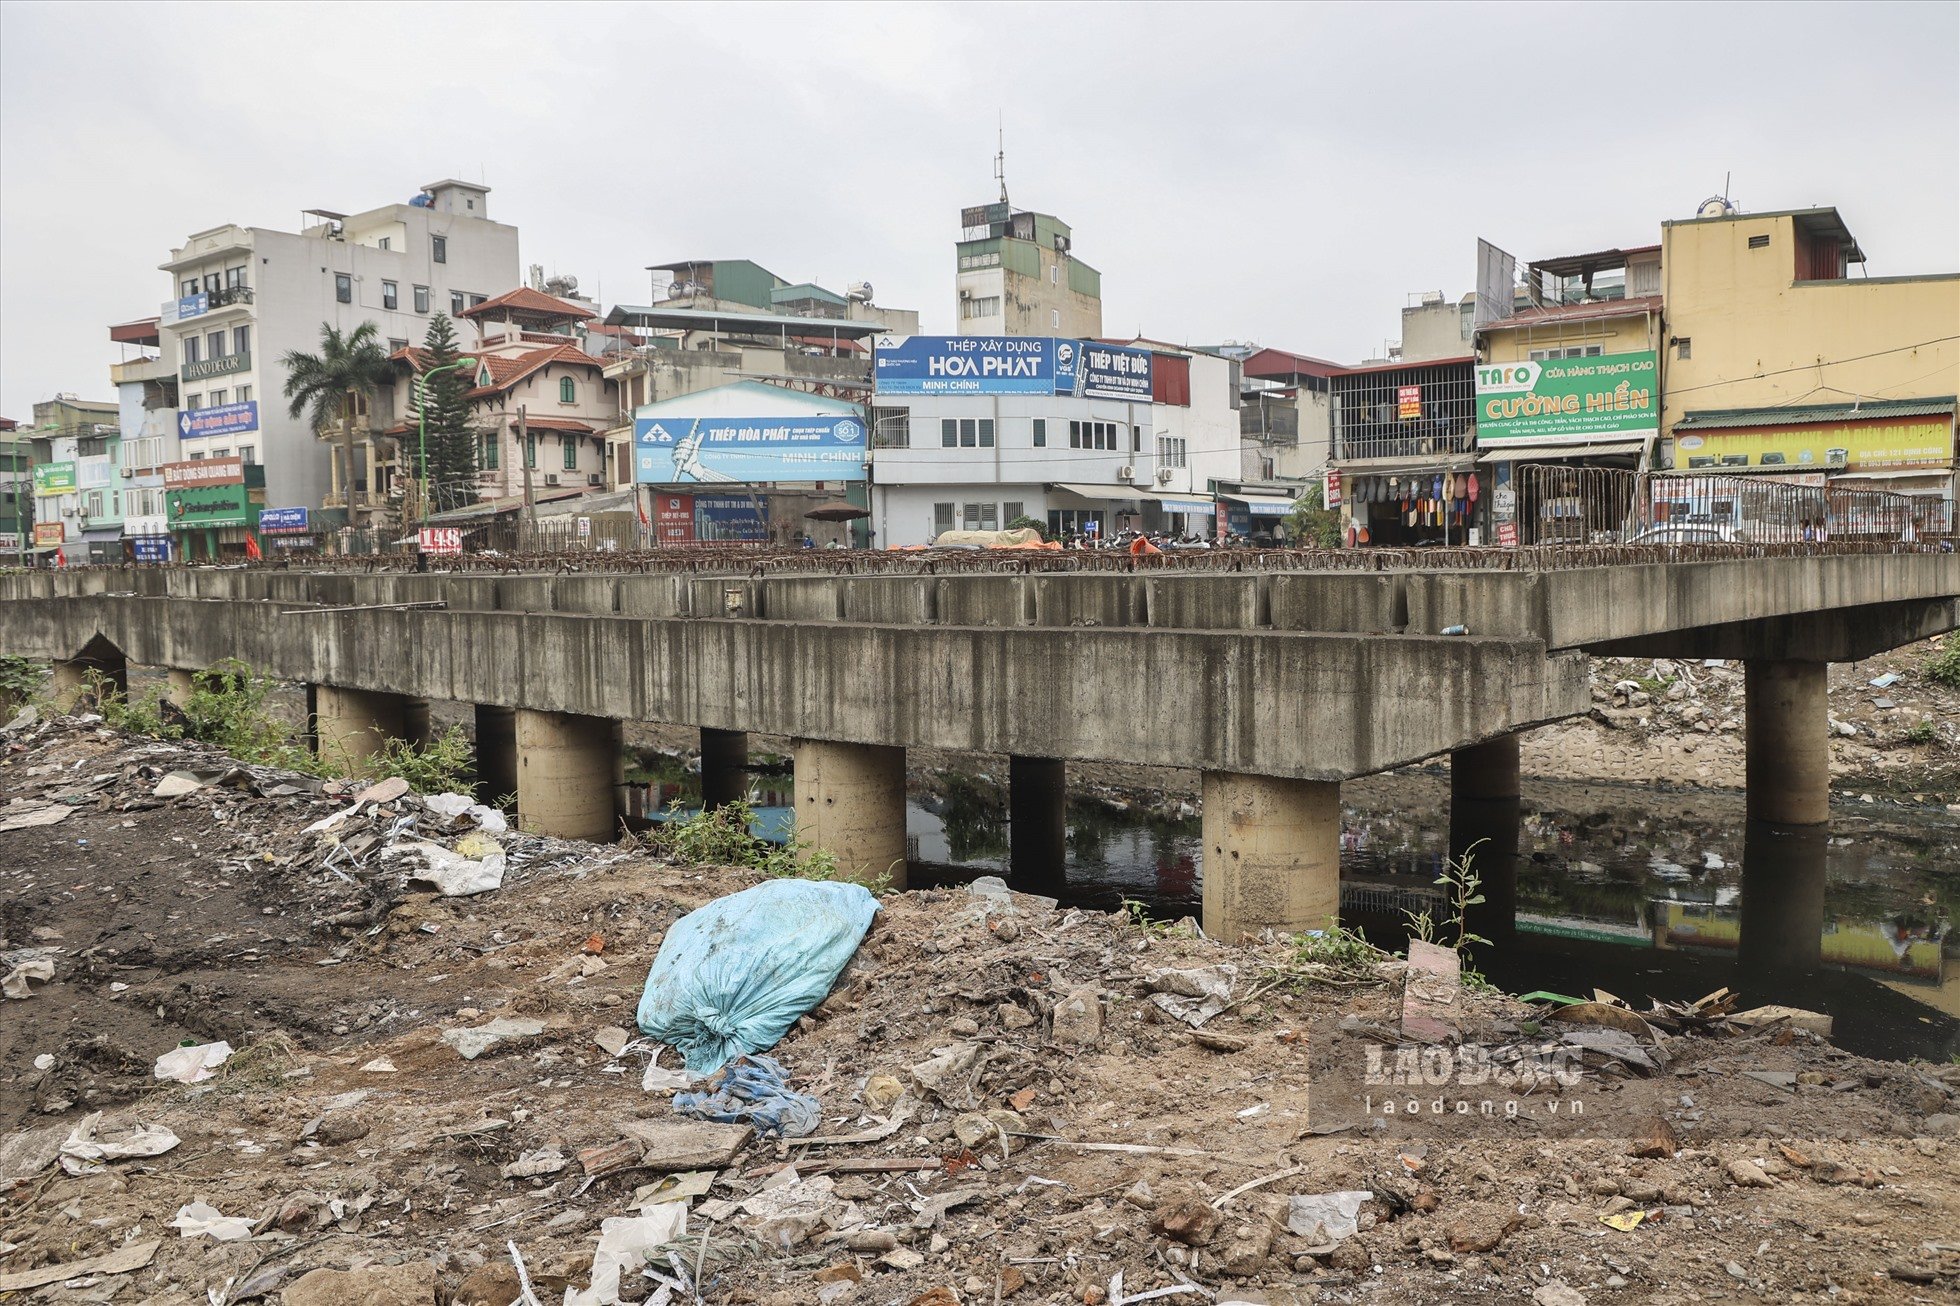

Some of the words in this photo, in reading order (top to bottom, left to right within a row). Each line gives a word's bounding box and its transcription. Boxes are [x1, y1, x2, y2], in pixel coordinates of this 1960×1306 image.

[946, 340, 977, 352] THÉP
[980, 339, 1002, 352] XÂY
[1006, 341, 1041, 354] DỰNG
[189, 362, 210, 377] HAND
[212, 356, 239, 373] DECOR
[930, 356, 979, 376] HÒA
[983, 356, 1041, 376] PHÁT
[1090, 350, 1111, 370] THÉP
[1113, 353, 1130, 375] VIỆT
[1131, 354, 1148, 374] ĐỨC
[1546, 367, 1566, 378] CỬA
[1567, 366, 1595, 376] HÀNG
[1596, 363, 1629, 375] THẠCH
[1631, 361, 1654, 370] CAO
[950, 380, 979, 389] CHÍNH
[1479, 367, 1530, 385] TAFO
[1486, 392, 1580, 419] CƯỜNG
[709, 427, 736, 441] THÉP
[738, 426, 760, 441] HÒA
[762, 426, 791, 440] PHÁT
[1773, 431, 1822, 447] KARAOKE
[1885, 426, 1905, 441] GIA
[782, 453, 816, 463] MINH
[820, 450, 860, 461] CHÍNH
[1500, 532, 1516, 540] THUÊ
